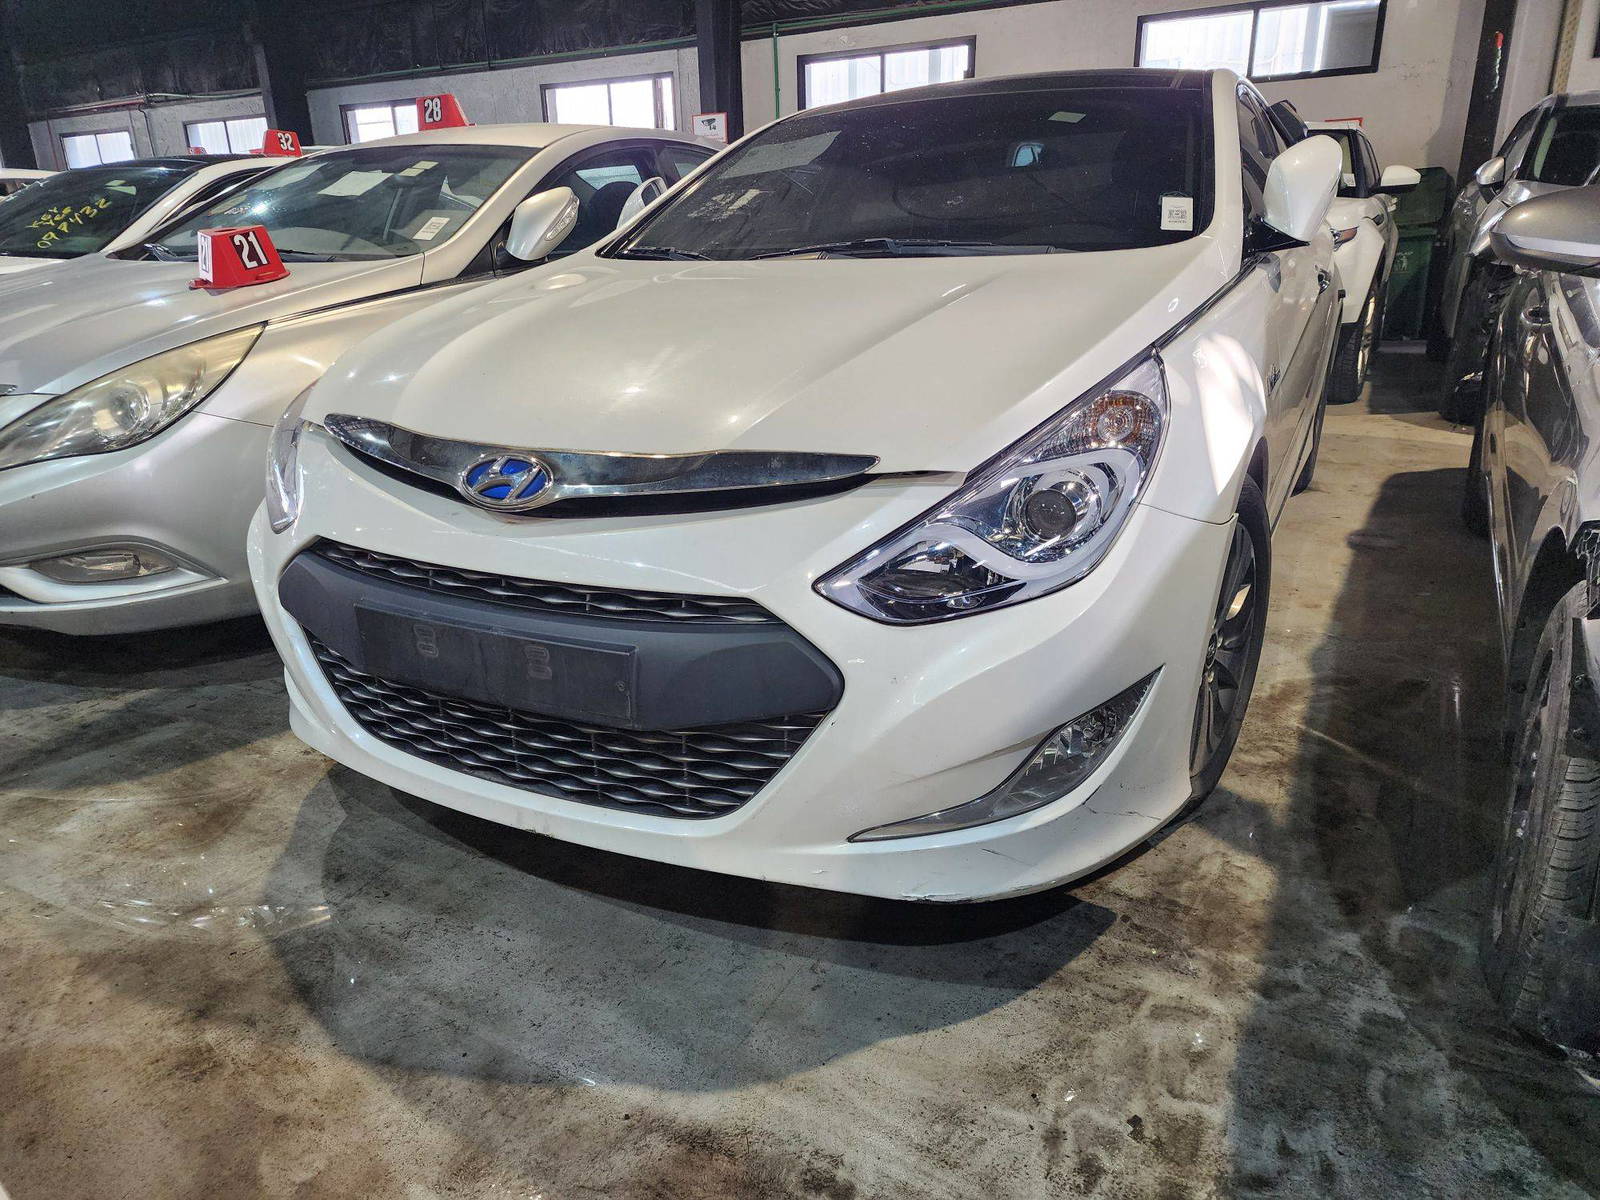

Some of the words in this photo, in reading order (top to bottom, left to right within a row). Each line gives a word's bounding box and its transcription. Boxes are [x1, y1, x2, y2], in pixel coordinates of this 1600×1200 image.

[424, 97, 442, 123] 28
[277, 132, 295, 151] 32
[233, 231, 269, 269] 21
